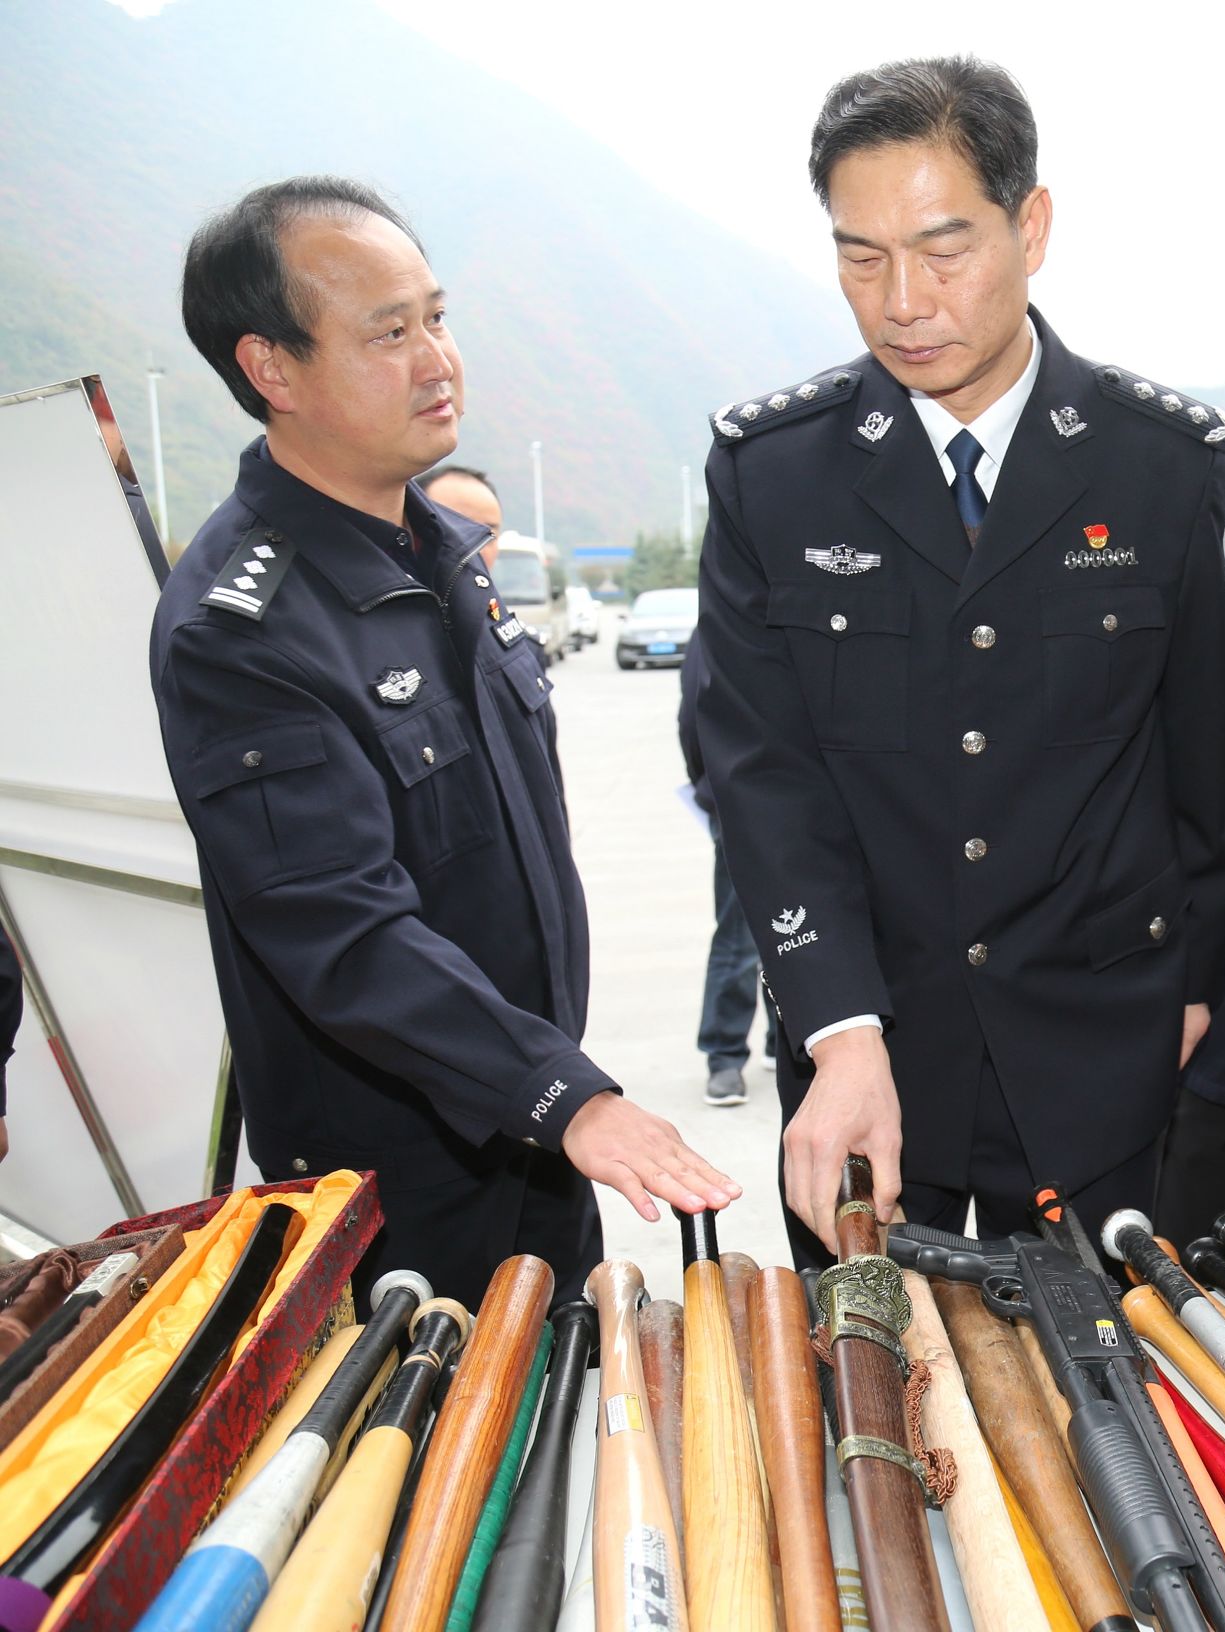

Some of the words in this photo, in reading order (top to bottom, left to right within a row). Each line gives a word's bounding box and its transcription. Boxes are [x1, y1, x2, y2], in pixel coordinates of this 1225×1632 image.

[1065, 547, 1138, 569] 000001
[777, 930, 818, 956] POLICE
[531, 1080, 568, 1122] POLICE
